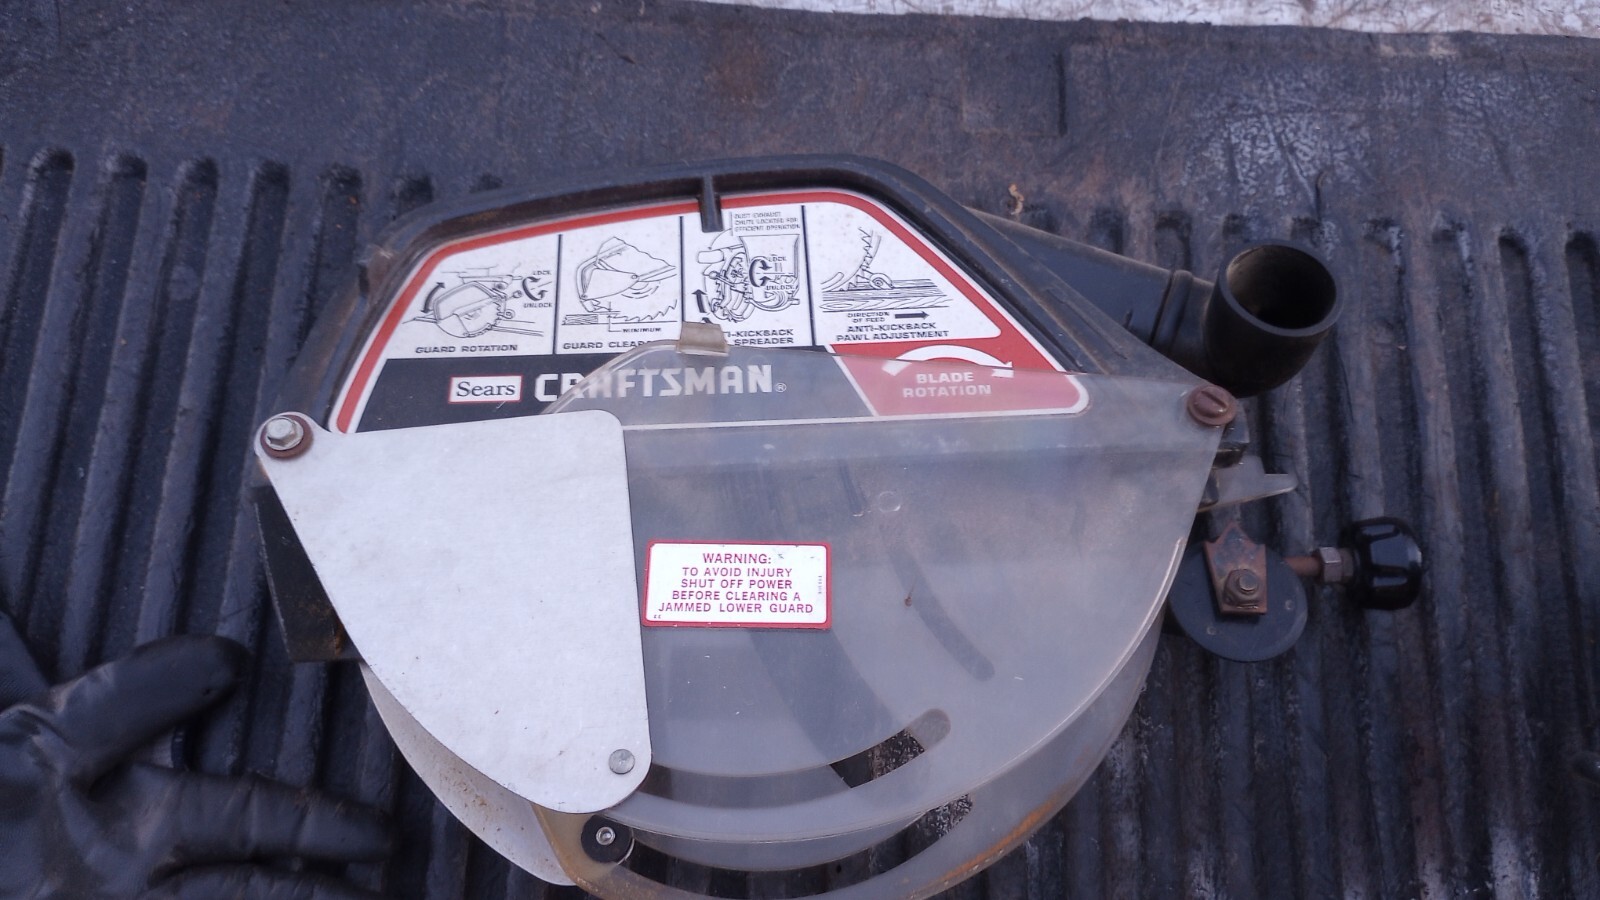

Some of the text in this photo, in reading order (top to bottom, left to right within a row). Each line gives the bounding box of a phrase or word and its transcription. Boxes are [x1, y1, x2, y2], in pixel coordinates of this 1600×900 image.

[847, 322, 937, 333] ANTI-KICKBACK
[734, 337, 794, 346] SPREADER
[836, 330, 950, 342] PAWL ADJUSTMENT
[415, 344, 518, 354] GUARD ROTATION
[562, 341, 604, 350] GUARD
[916, 371, 975, 384] BLADE
[456, 380, 517, 397] Sears
[902, 384, 992, 398] ROTATION
[703, 553, 772, 565] WARNING:
[682, 567, 793, 578] TO AVOID INJURY
[681, 579, 793, 589] SHUT OFF POWER
[672, 590, 801, 601] BEFORE CLEARING A
[658, 602, 814, 613] JAMMED LOWER GUARD
